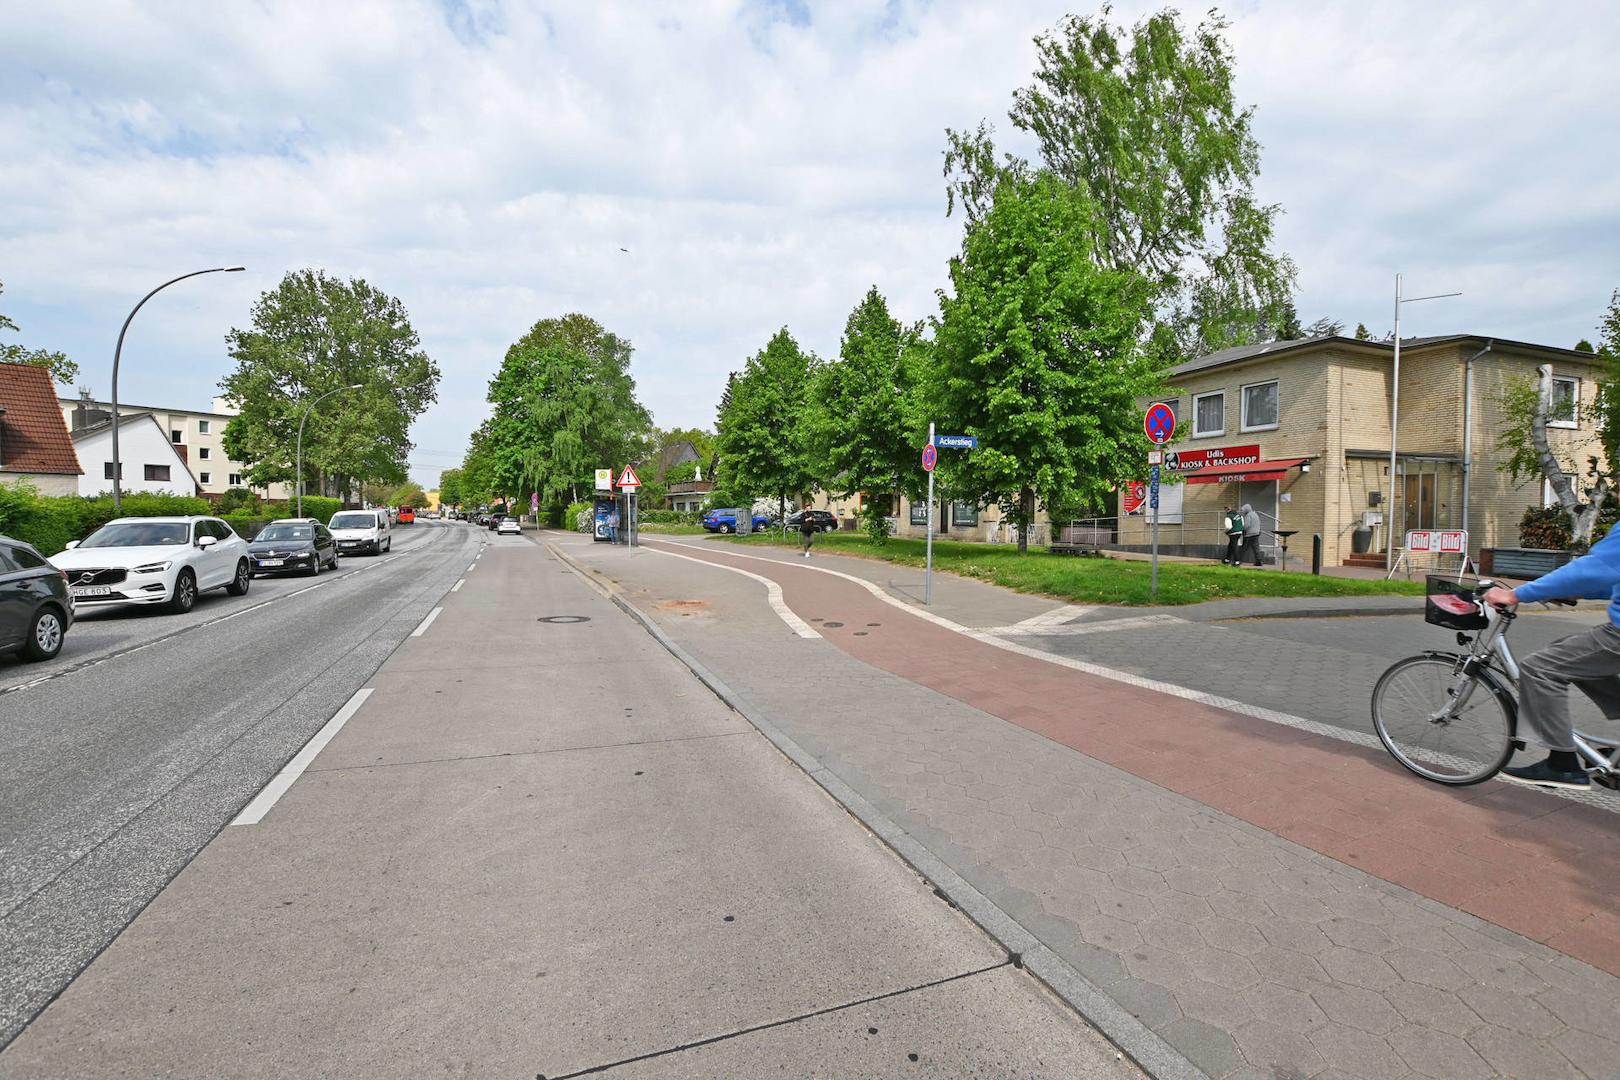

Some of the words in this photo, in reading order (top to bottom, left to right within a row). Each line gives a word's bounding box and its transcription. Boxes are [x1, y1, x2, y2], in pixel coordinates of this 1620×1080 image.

[939, 437, 973, 447] Ackerstieg
[1181, 460, 1203, 469] KIOSK
[1205, 459, 1211, 467] &
[1213, 456, 1257, 467] BACKSHOP
[1218, 474, 1246, 483] KIOSK
[1412, 533, 1429, 549] Bild
[1442, 533, 1460, 550] Bild
